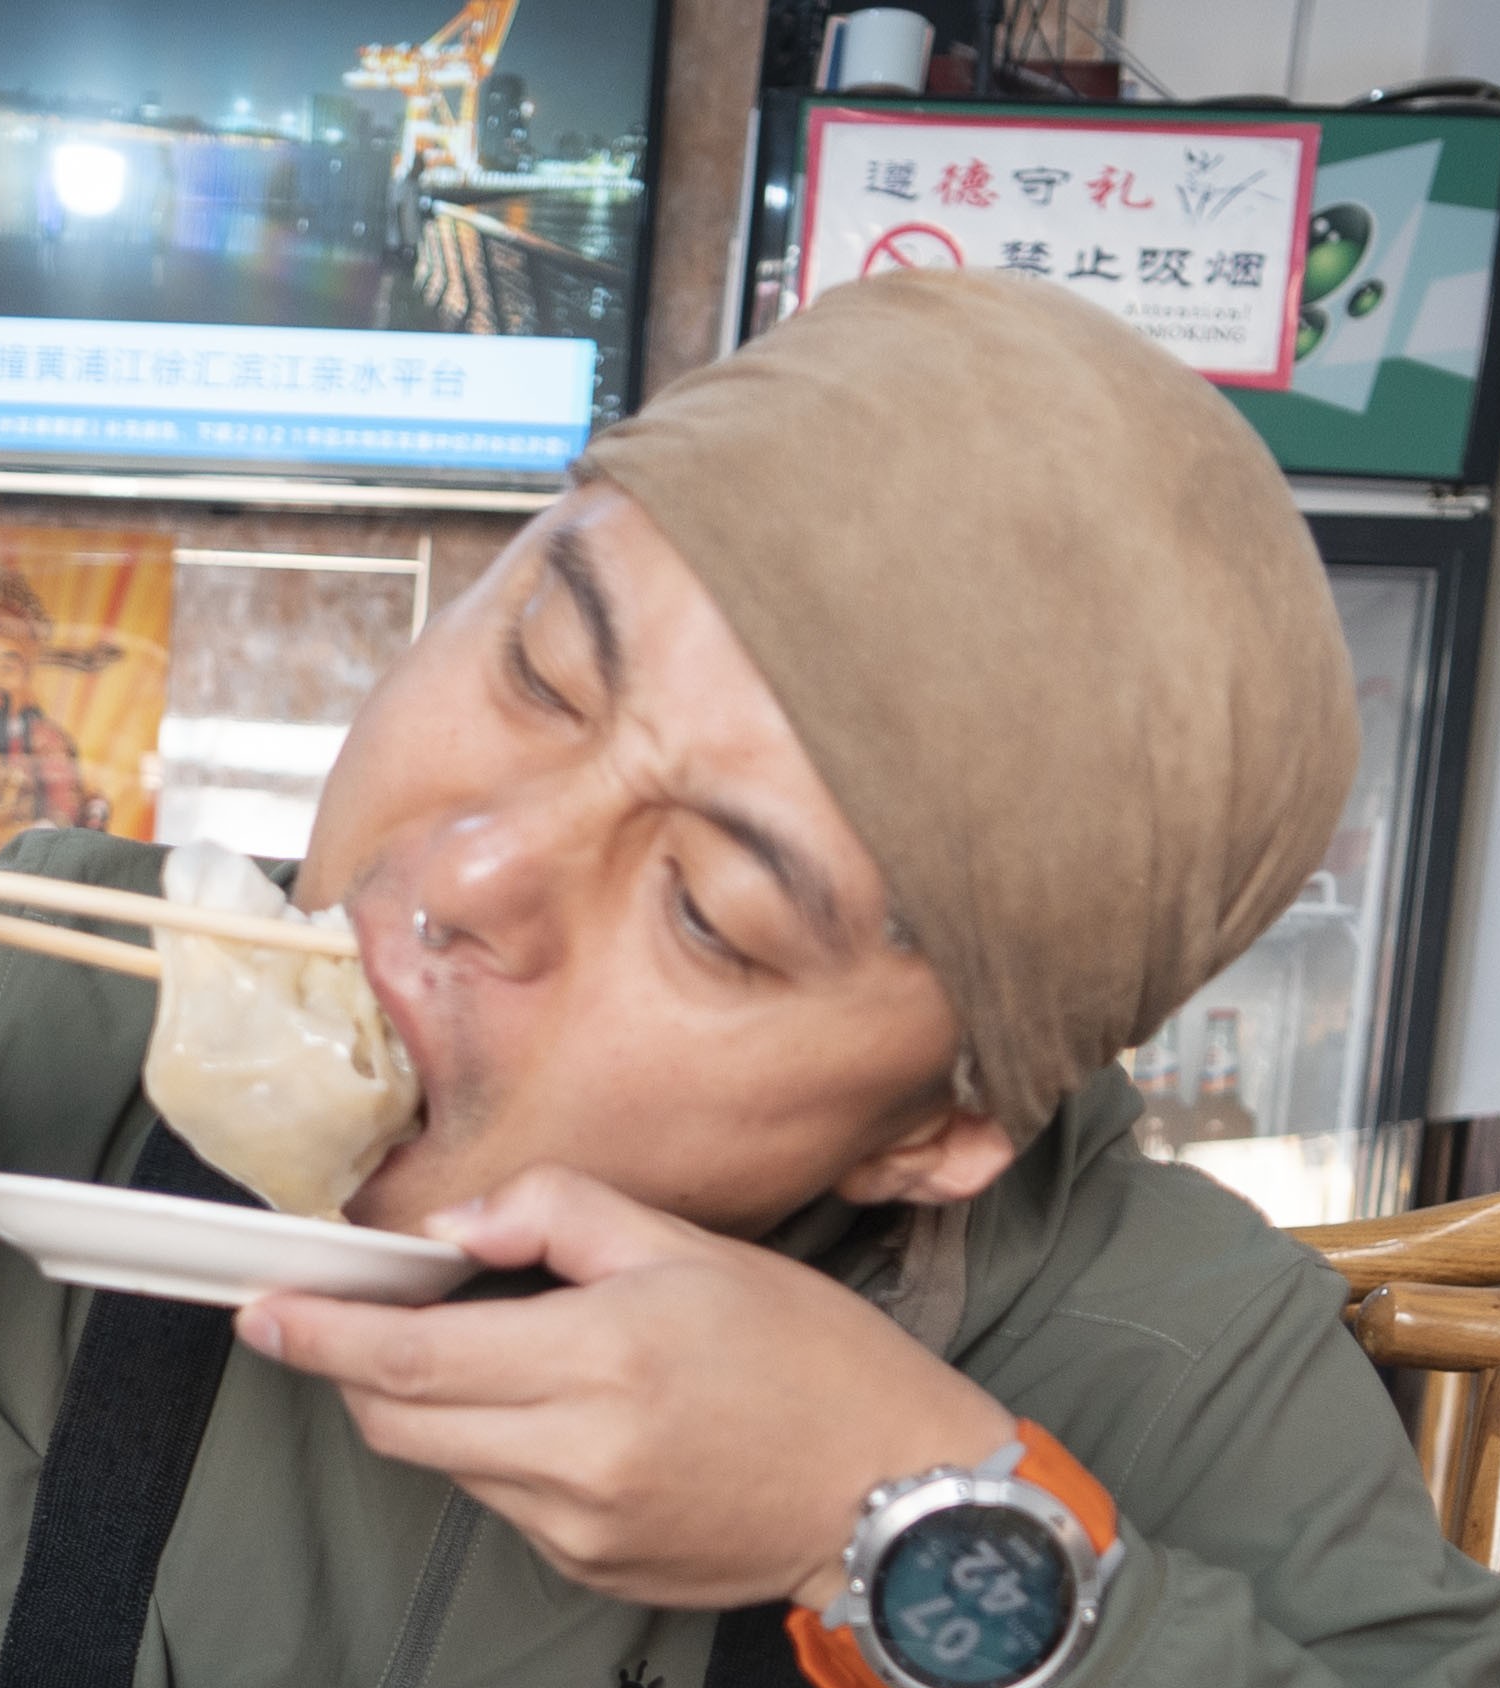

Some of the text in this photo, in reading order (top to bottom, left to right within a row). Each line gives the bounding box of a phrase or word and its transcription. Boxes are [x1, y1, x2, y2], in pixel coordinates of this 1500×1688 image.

[864, 156, 1155, 210] 遵德守礼
[999, 241, 1267, 288] 禁止吸烟
[1134, 323, 1247, 344] MOKING
